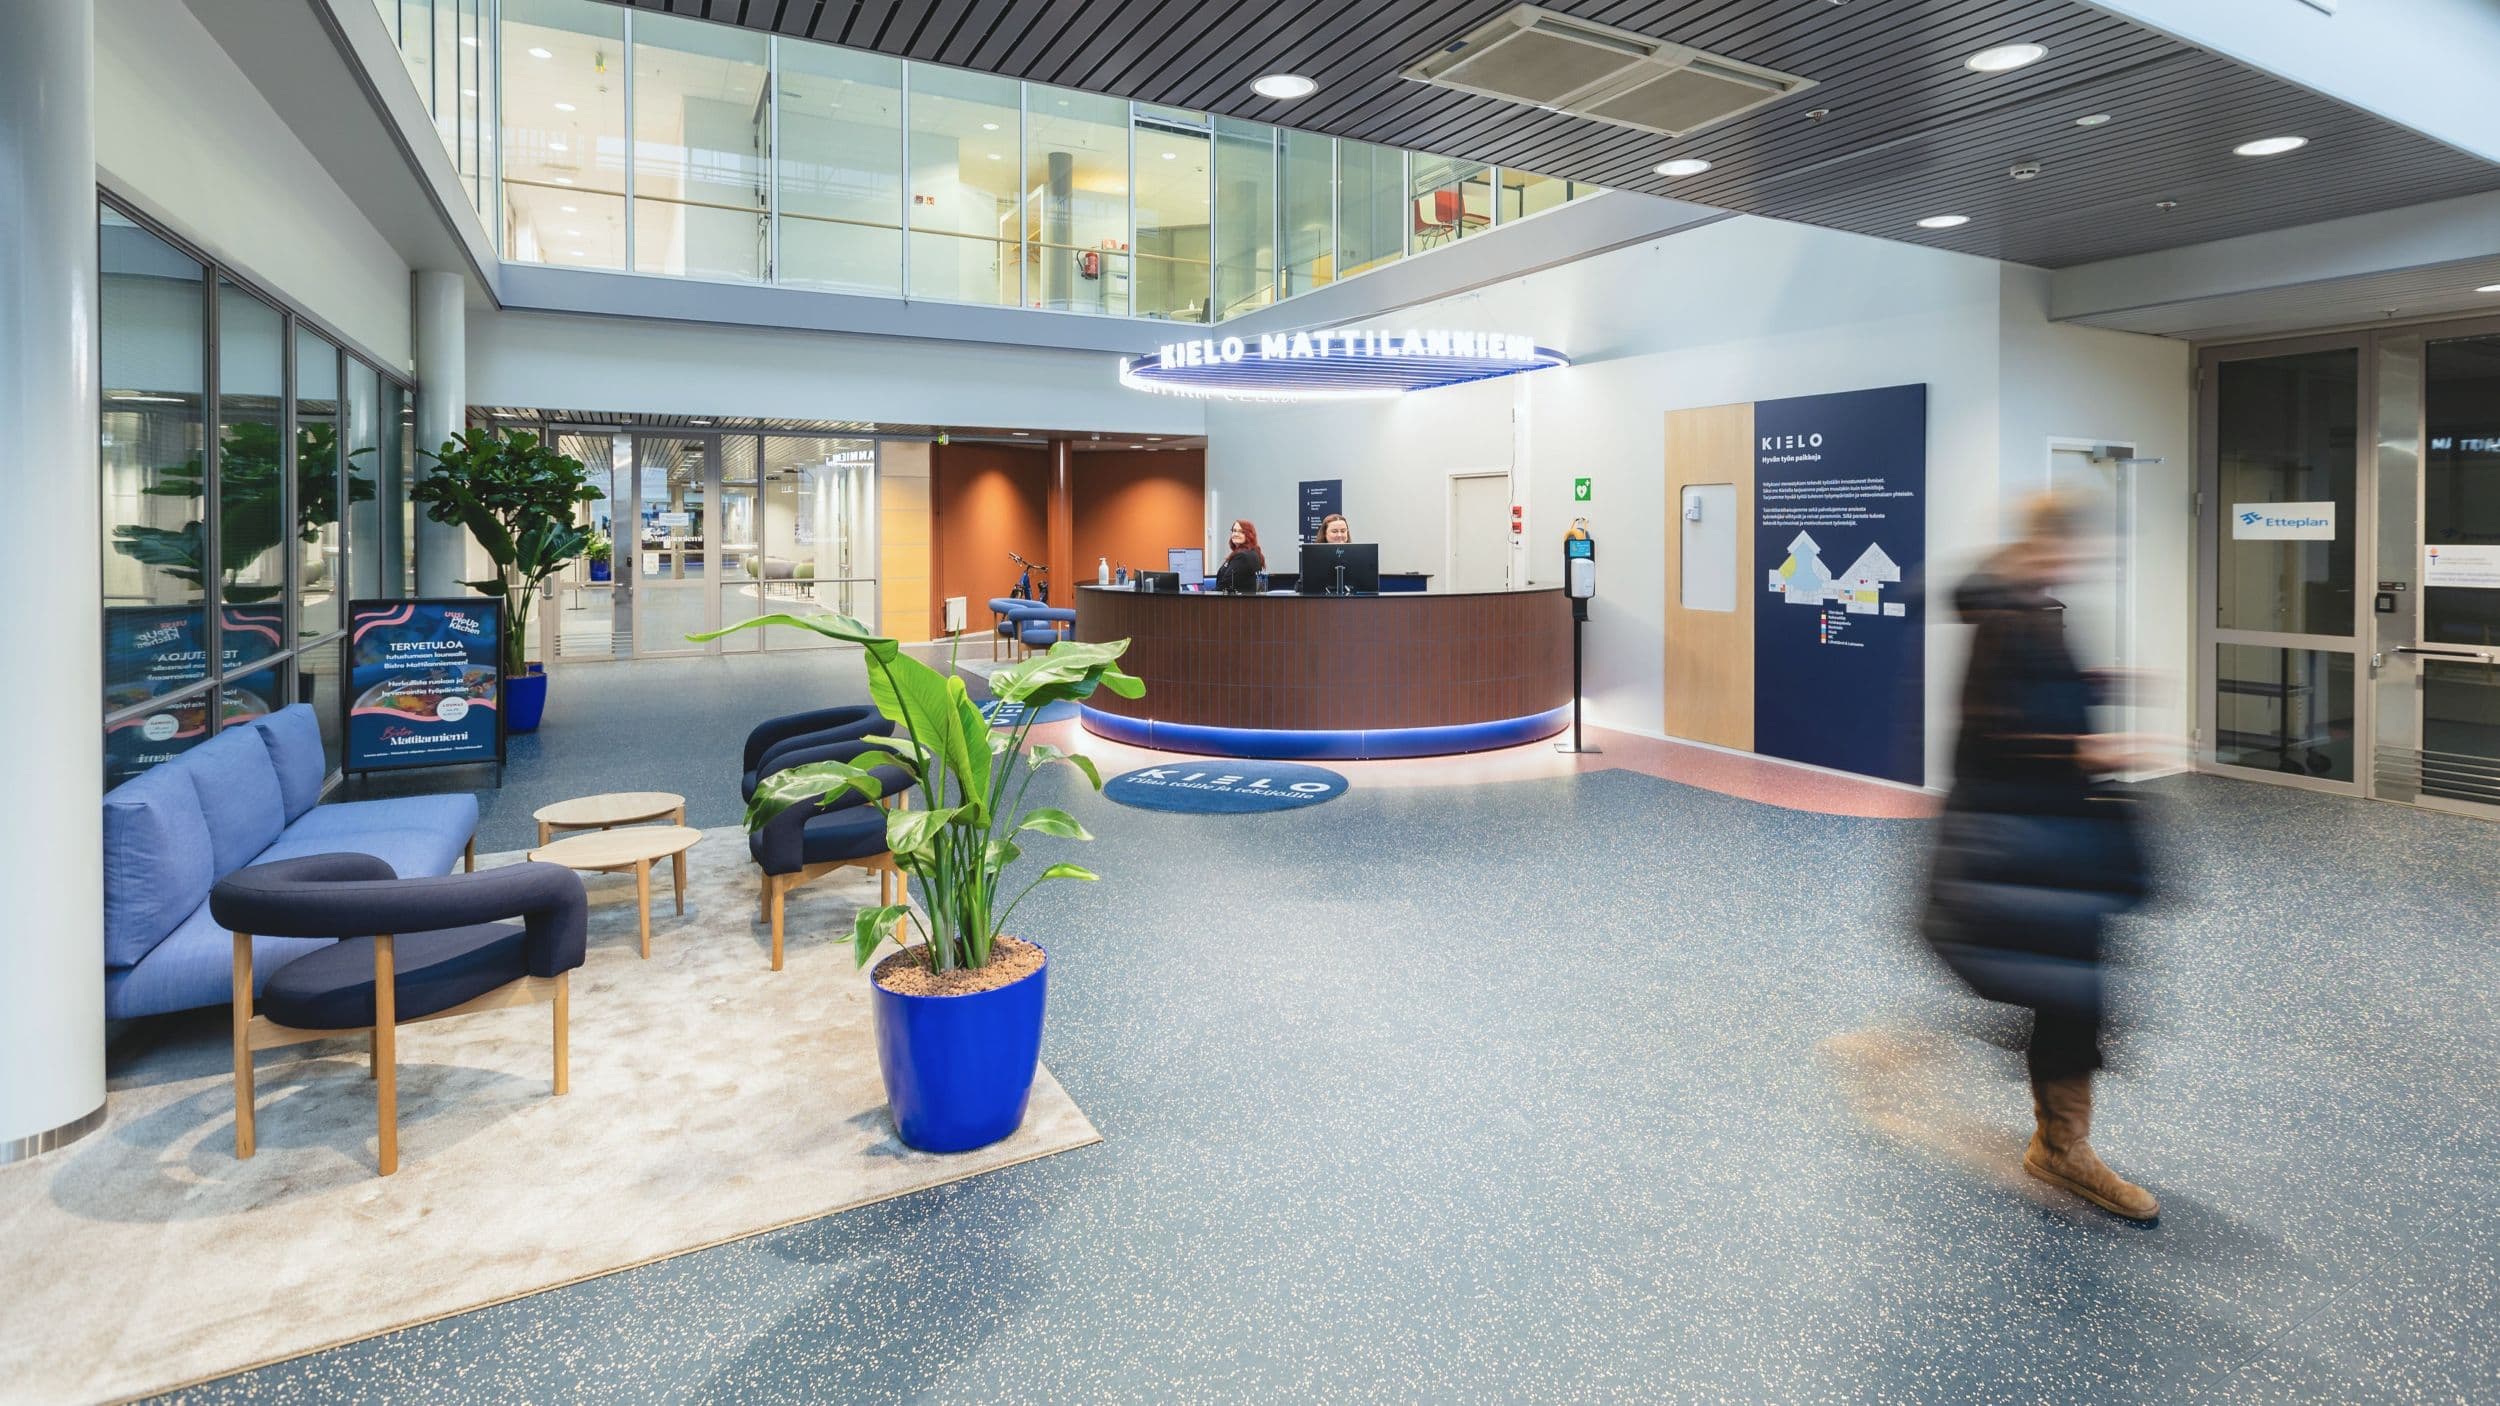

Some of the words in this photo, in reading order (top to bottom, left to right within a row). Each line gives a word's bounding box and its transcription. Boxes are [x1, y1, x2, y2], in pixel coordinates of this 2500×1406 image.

[1159, 336, 1245, 370] KIELO
[1261, 329, 1535, 361] MATTILANNIEMI
[1762, 433, 1823, 450] KIELO
[1762, 456, 1780, 464] Hyvän
[1780, 454, 1794, 463] työn
[2265, 516, 2328, 528] Etteplan
[390, 640, 464, 652] TERVETULOA
[386, 652, 433, 660] tutustumaan
[434, 650, 467, 658] lounaalle
[384, 661, 404, 670] Bistro
[406, 658, 468, 668] Mattilanniemeen!
[390, 731, 468, 746] Mattilanniemi
[1137, 768, 1331, 794] KIELO
